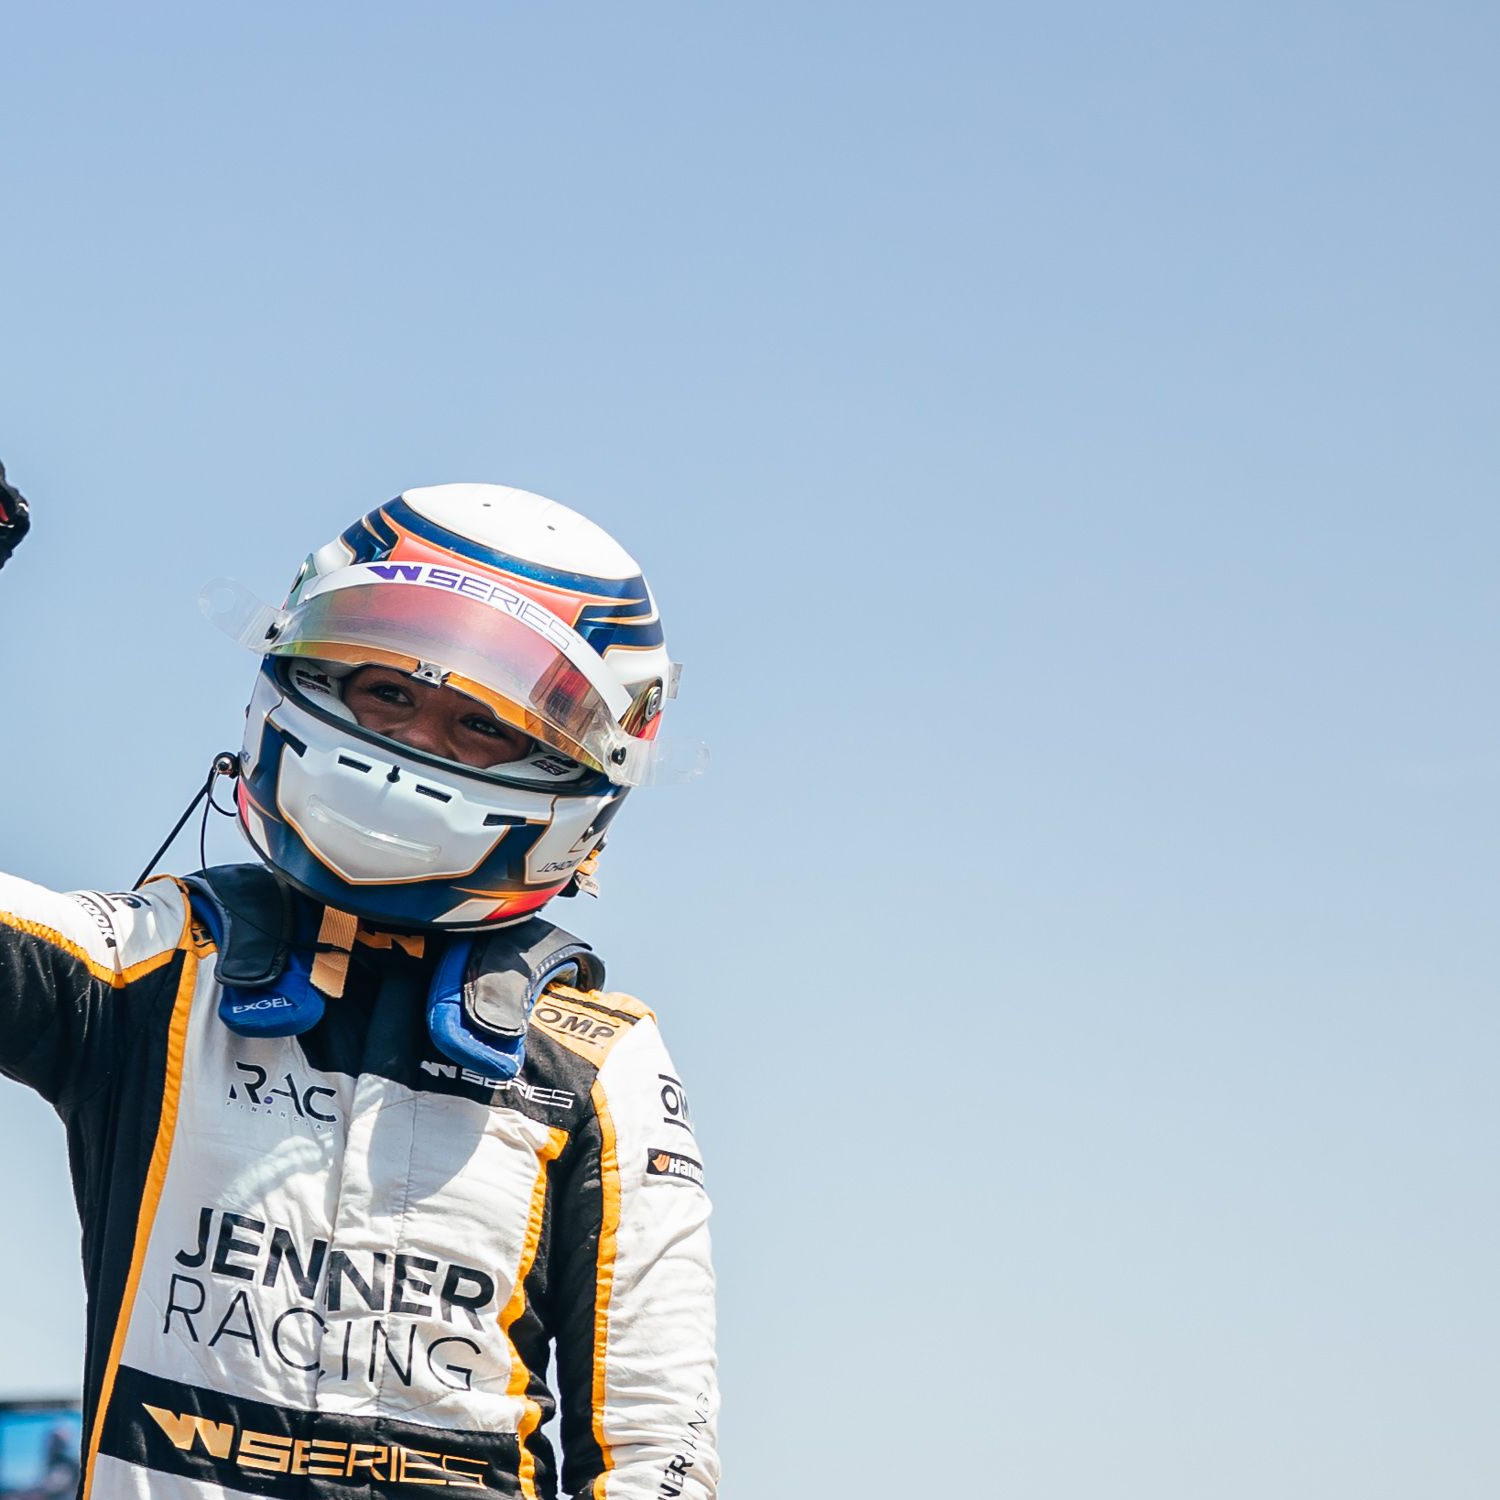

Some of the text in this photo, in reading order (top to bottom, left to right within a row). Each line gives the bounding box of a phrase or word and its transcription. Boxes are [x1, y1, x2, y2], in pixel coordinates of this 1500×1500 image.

[535, 1007, 616, 1039] OMP
[174, 1206, 496, 1332] JENNER
[161, 1273, 483, 1392] RACING
